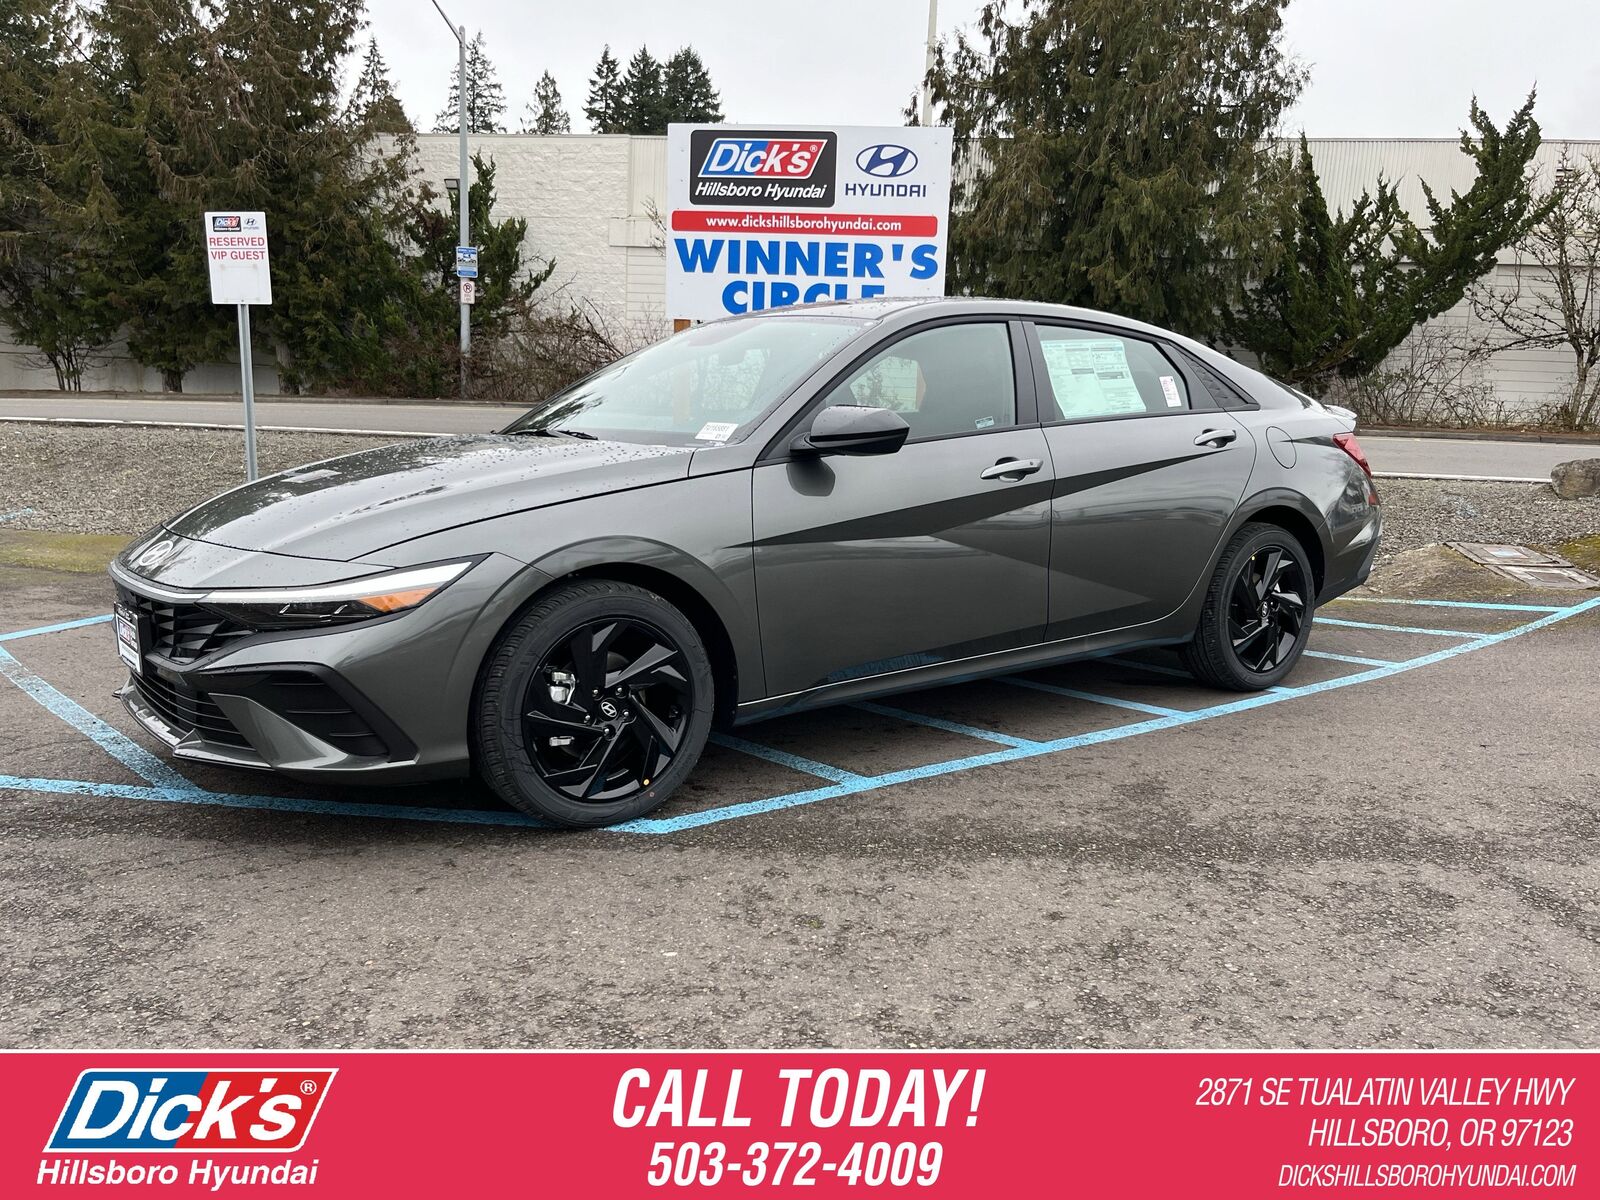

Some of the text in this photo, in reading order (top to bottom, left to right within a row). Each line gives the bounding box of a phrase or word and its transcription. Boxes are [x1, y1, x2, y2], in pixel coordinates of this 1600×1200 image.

[695, 182, 828, 201] Hillsboro Hyundai
[845, 183, 926, 198] HYUNDAI
[706, 214, 902, 233] www.dickshillsborohyundai.com
[209, 237, 265, 247] RESERVED
[211, 251, 266, 260] VIP GUEST
[674, 238, 938, 280] WINNER'S
